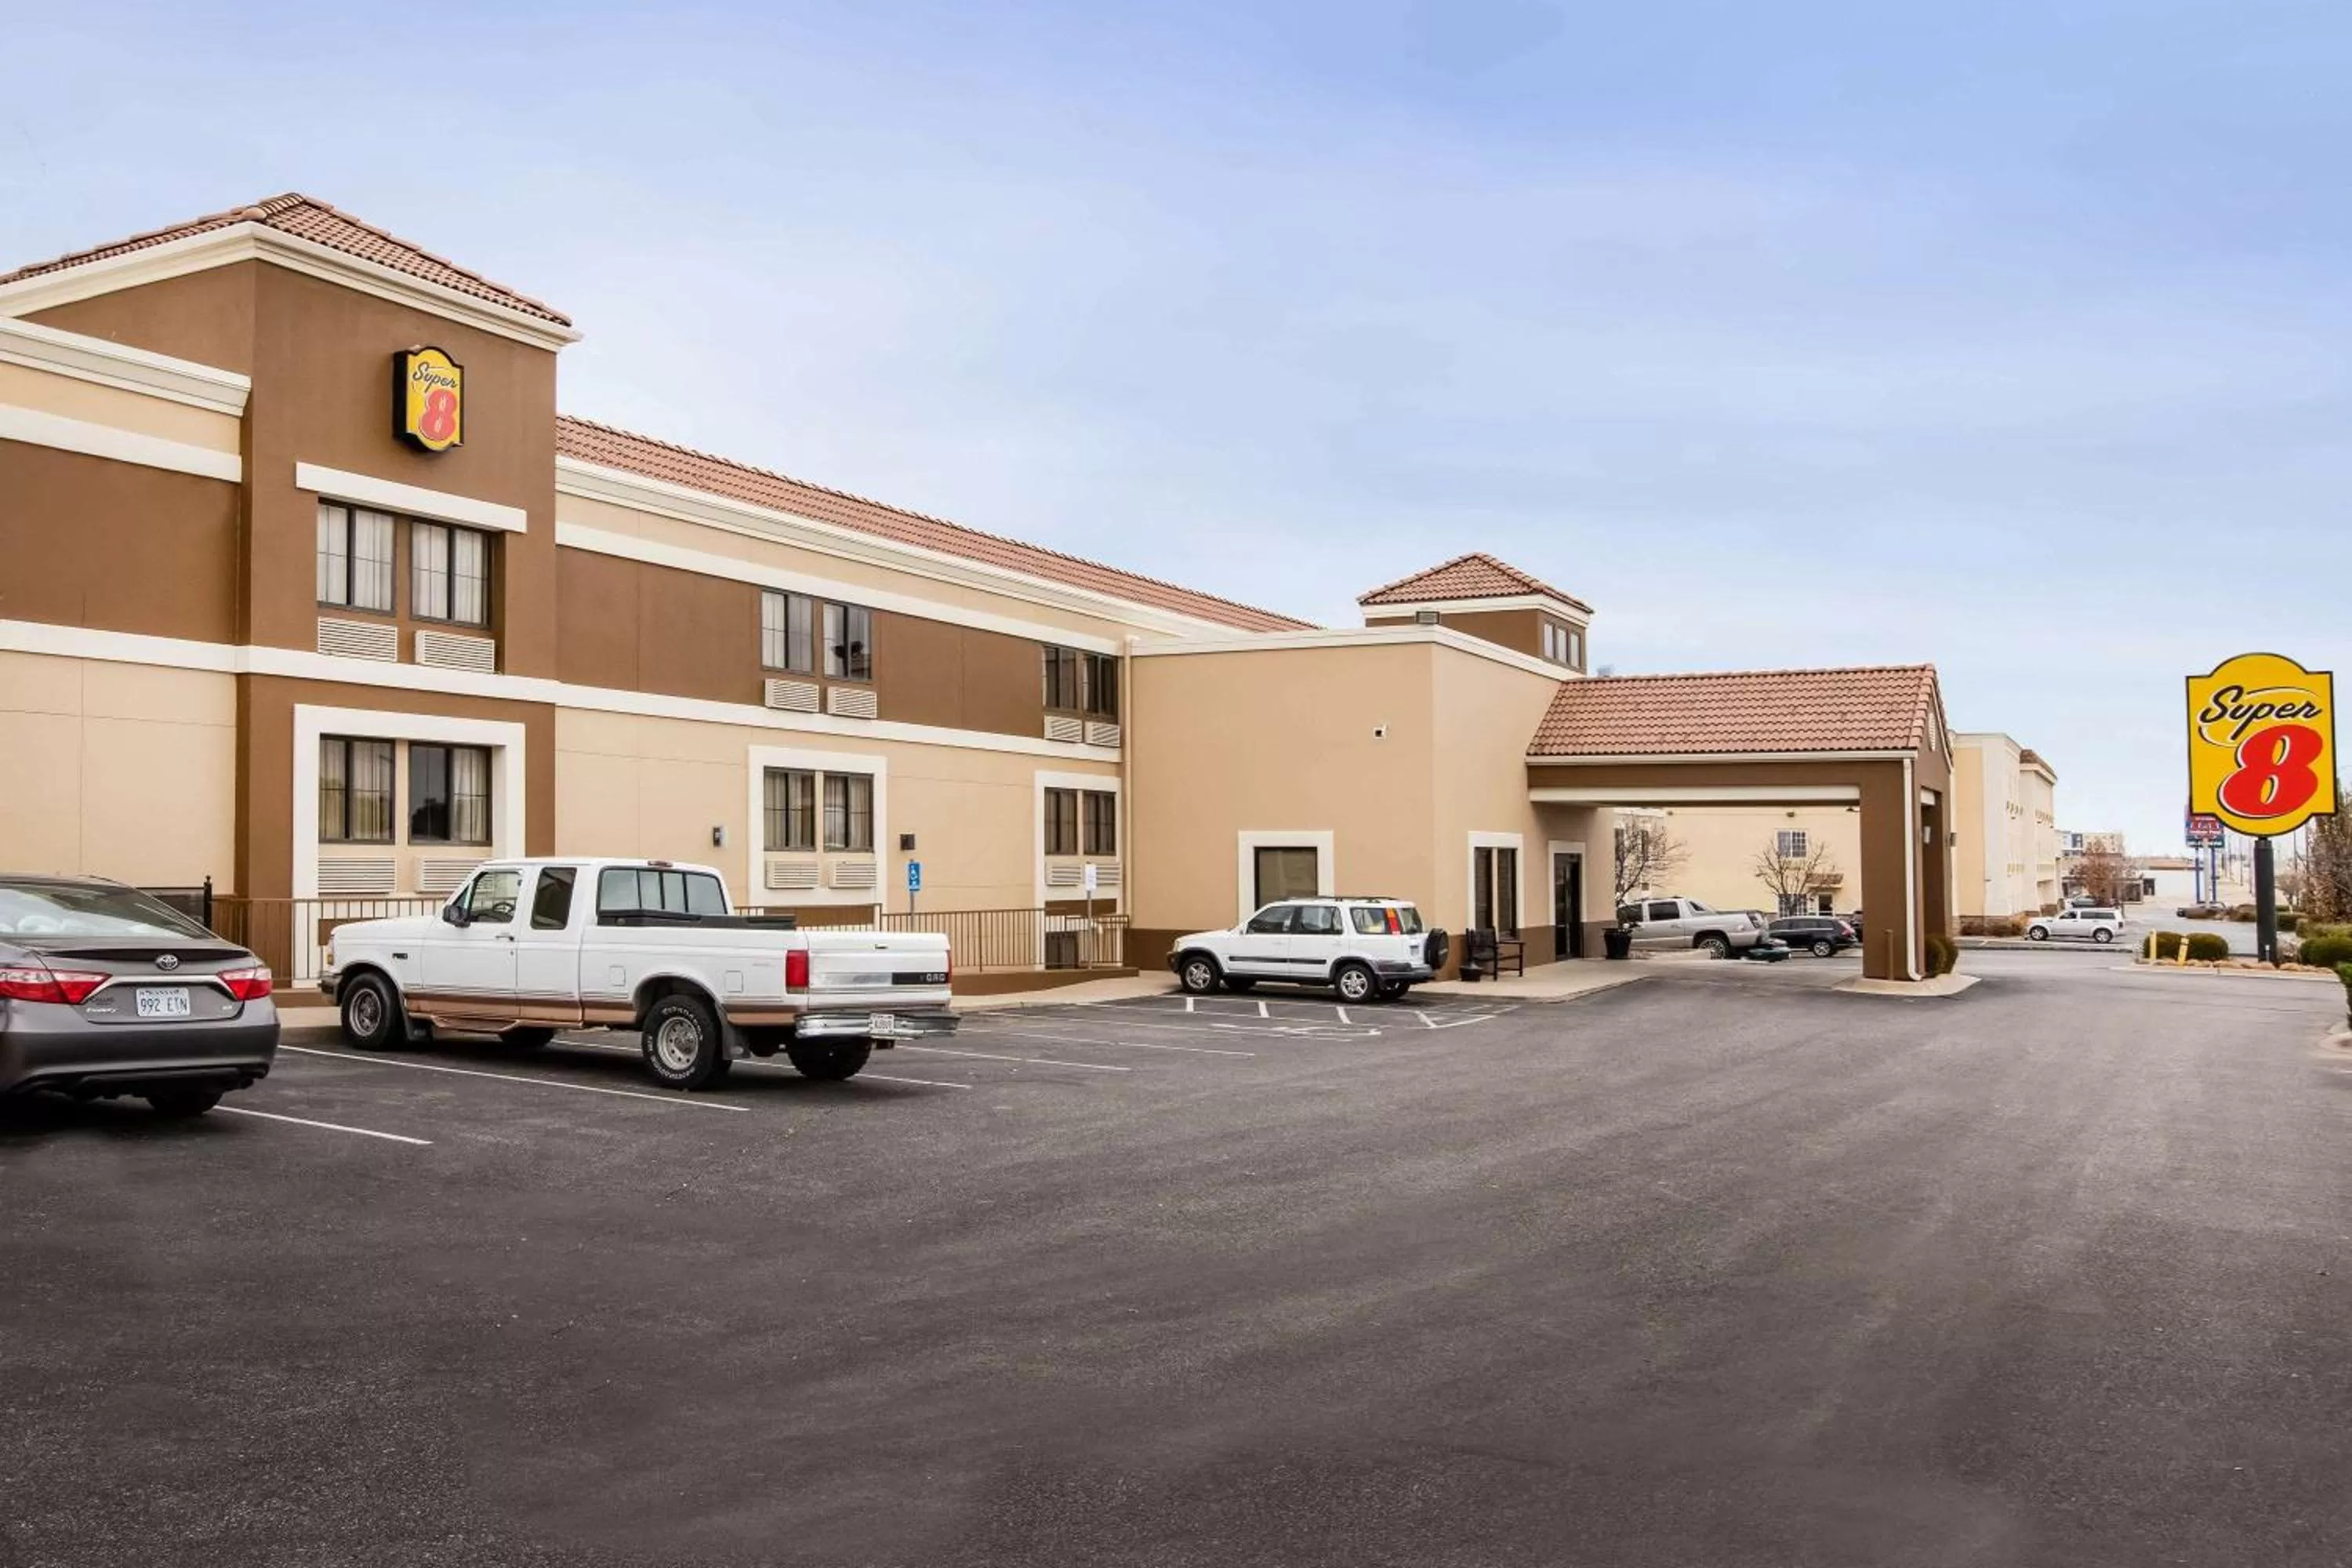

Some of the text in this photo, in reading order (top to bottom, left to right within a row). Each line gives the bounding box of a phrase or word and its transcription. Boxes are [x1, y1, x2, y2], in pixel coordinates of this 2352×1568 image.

[412, 361, 458, 394] Super
[419, 389, 457, 442] 8
[2199, 684, 2322, 742] Super
[2217, 724, 2323, 818] 8
